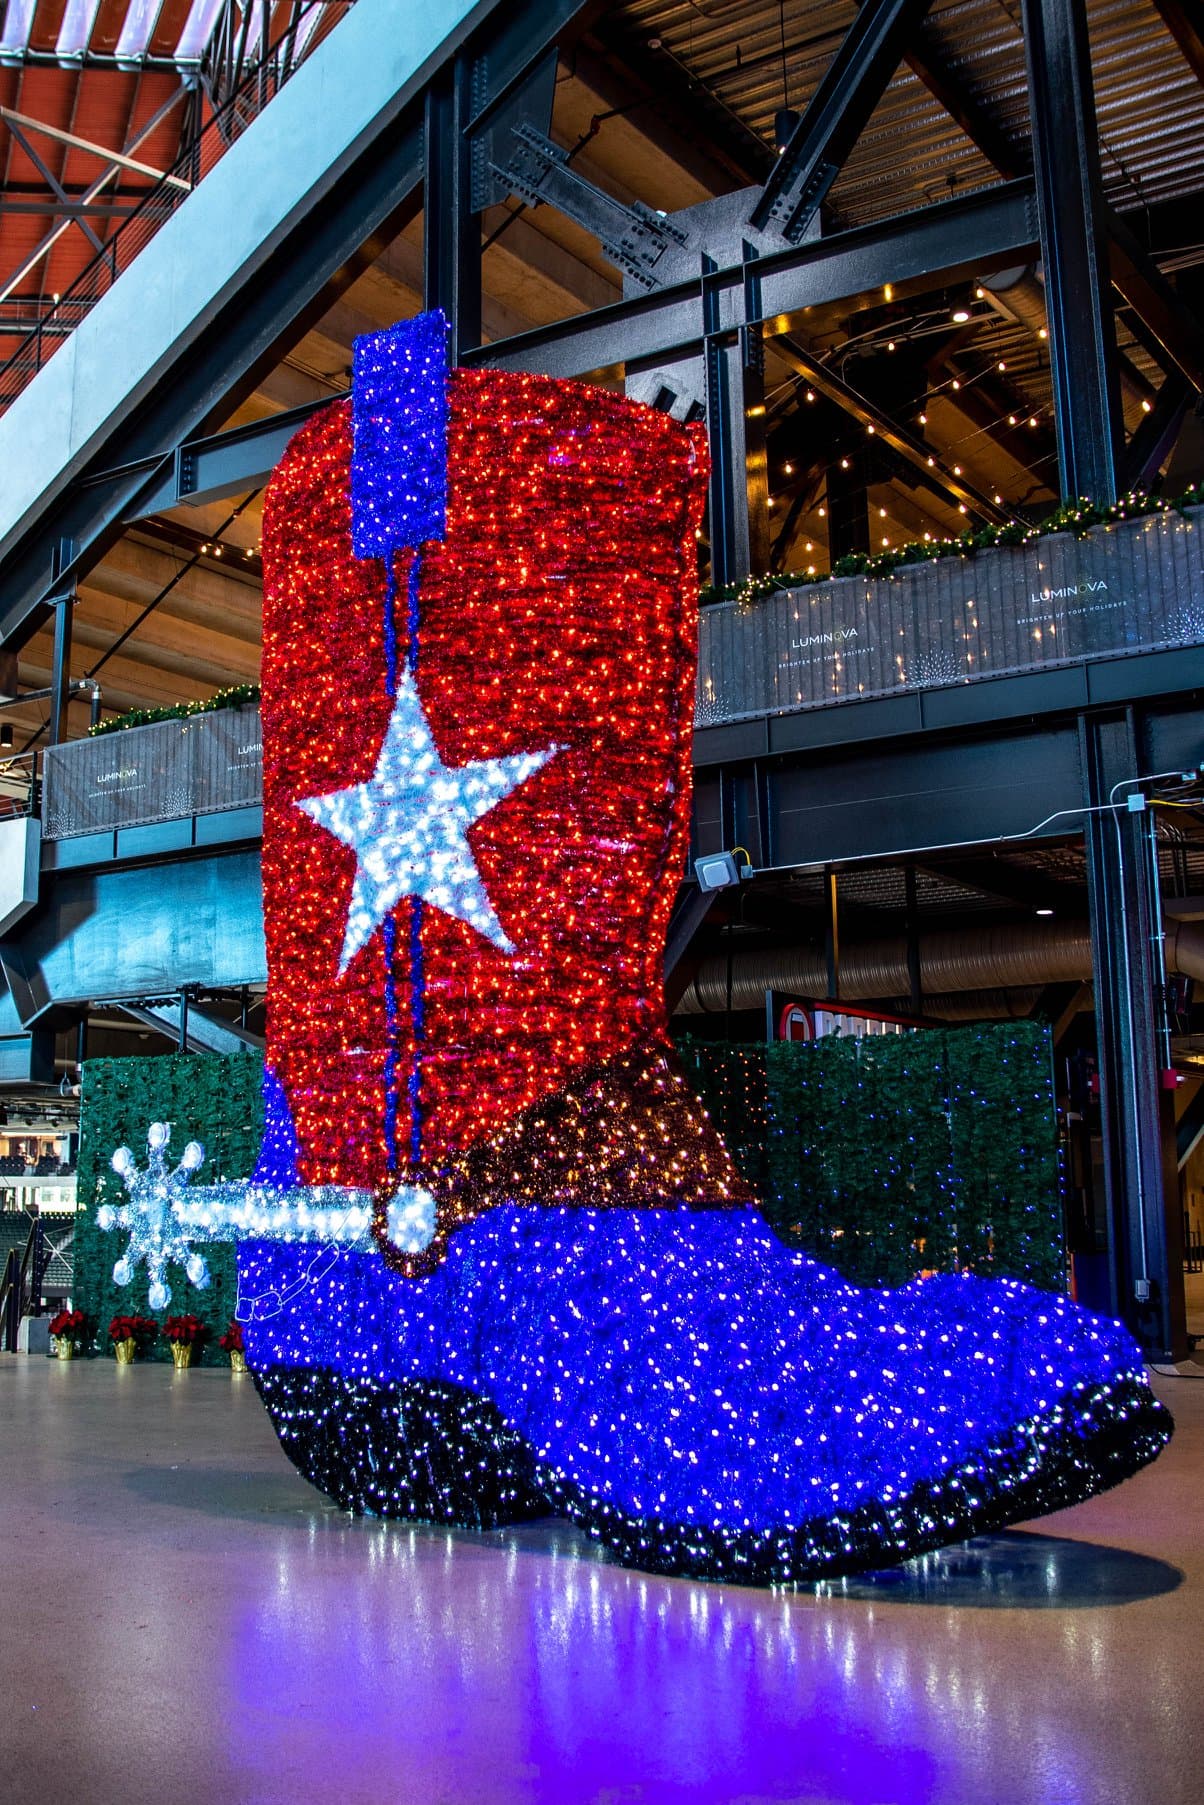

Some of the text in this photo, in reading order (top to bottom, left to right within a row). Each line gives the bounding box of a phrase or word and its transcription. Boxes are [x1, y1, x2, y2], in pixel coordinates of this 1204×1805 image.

[1031, 580, 1108, 602] LUMINOVA
[792, 628, 858, 648] LUMINOVA
[97, 768, 137, 783] LUMINOVA
